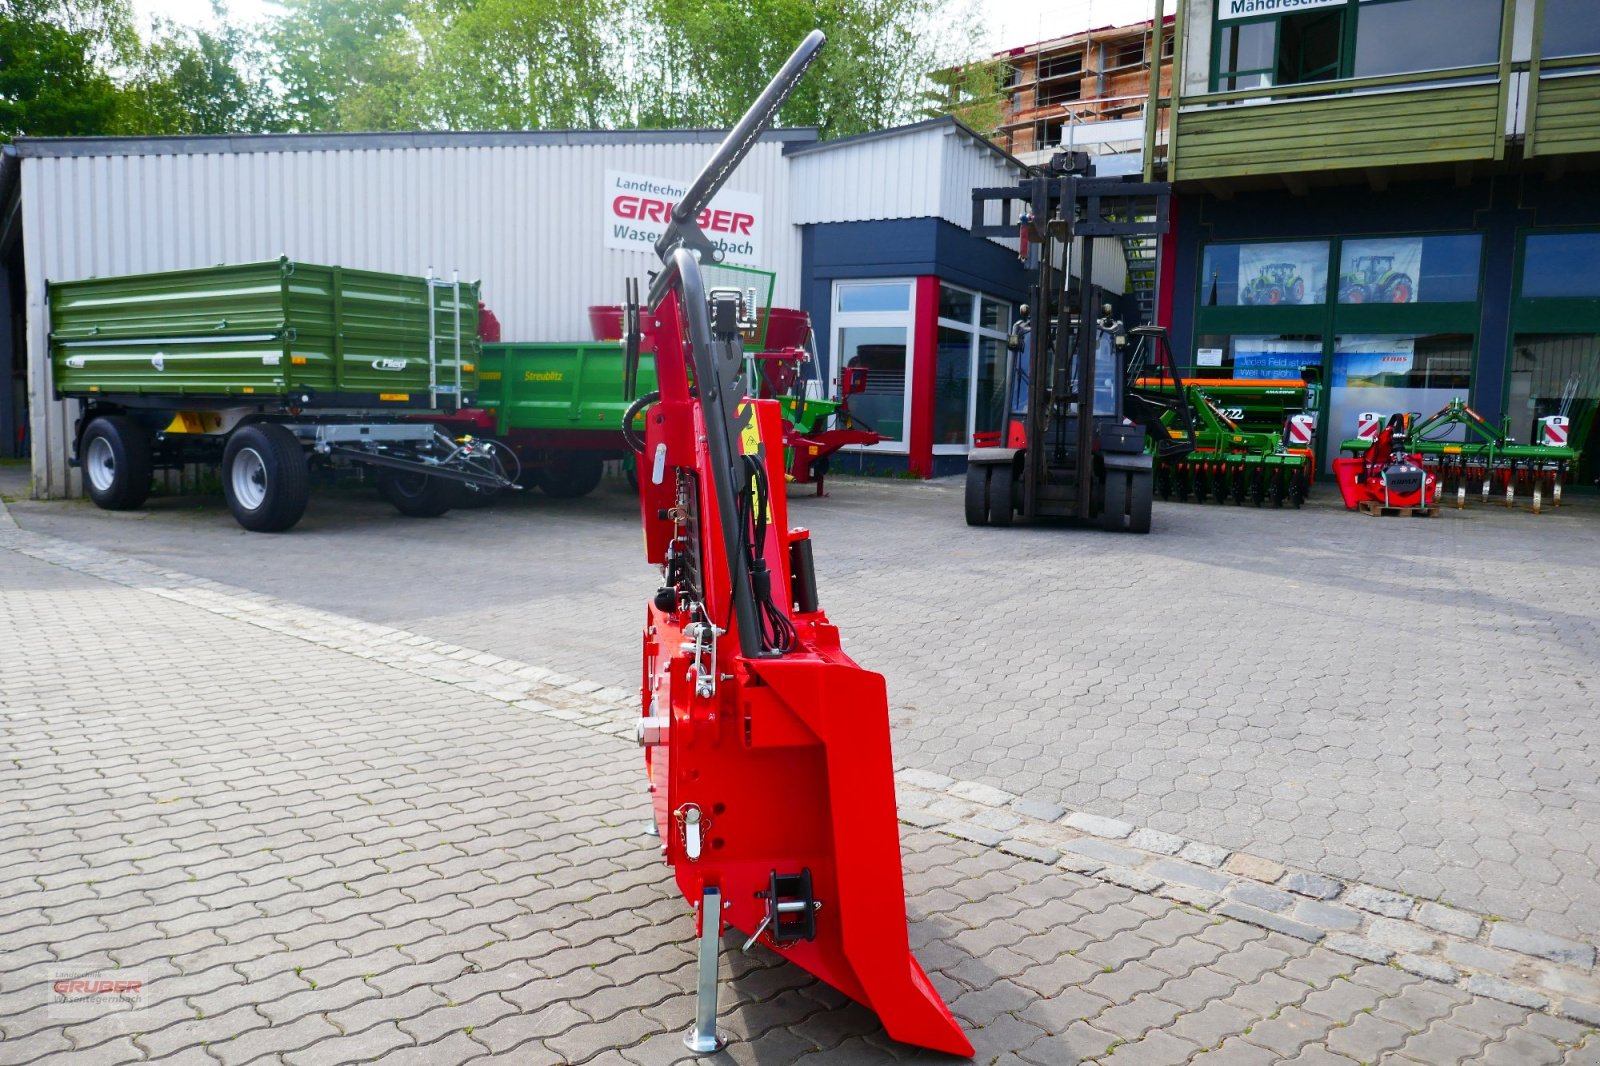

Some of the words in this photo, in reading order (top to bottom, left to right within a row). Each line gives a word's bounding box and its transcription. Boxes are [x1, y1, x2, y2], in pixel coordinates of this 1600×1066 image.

[616, 177, 687, 197] Landtechni
[612, 195, 755, 236] GRBER
[1268, 357, 1287, 366] Feld
[525, 371, 562, 381] Streublitz
